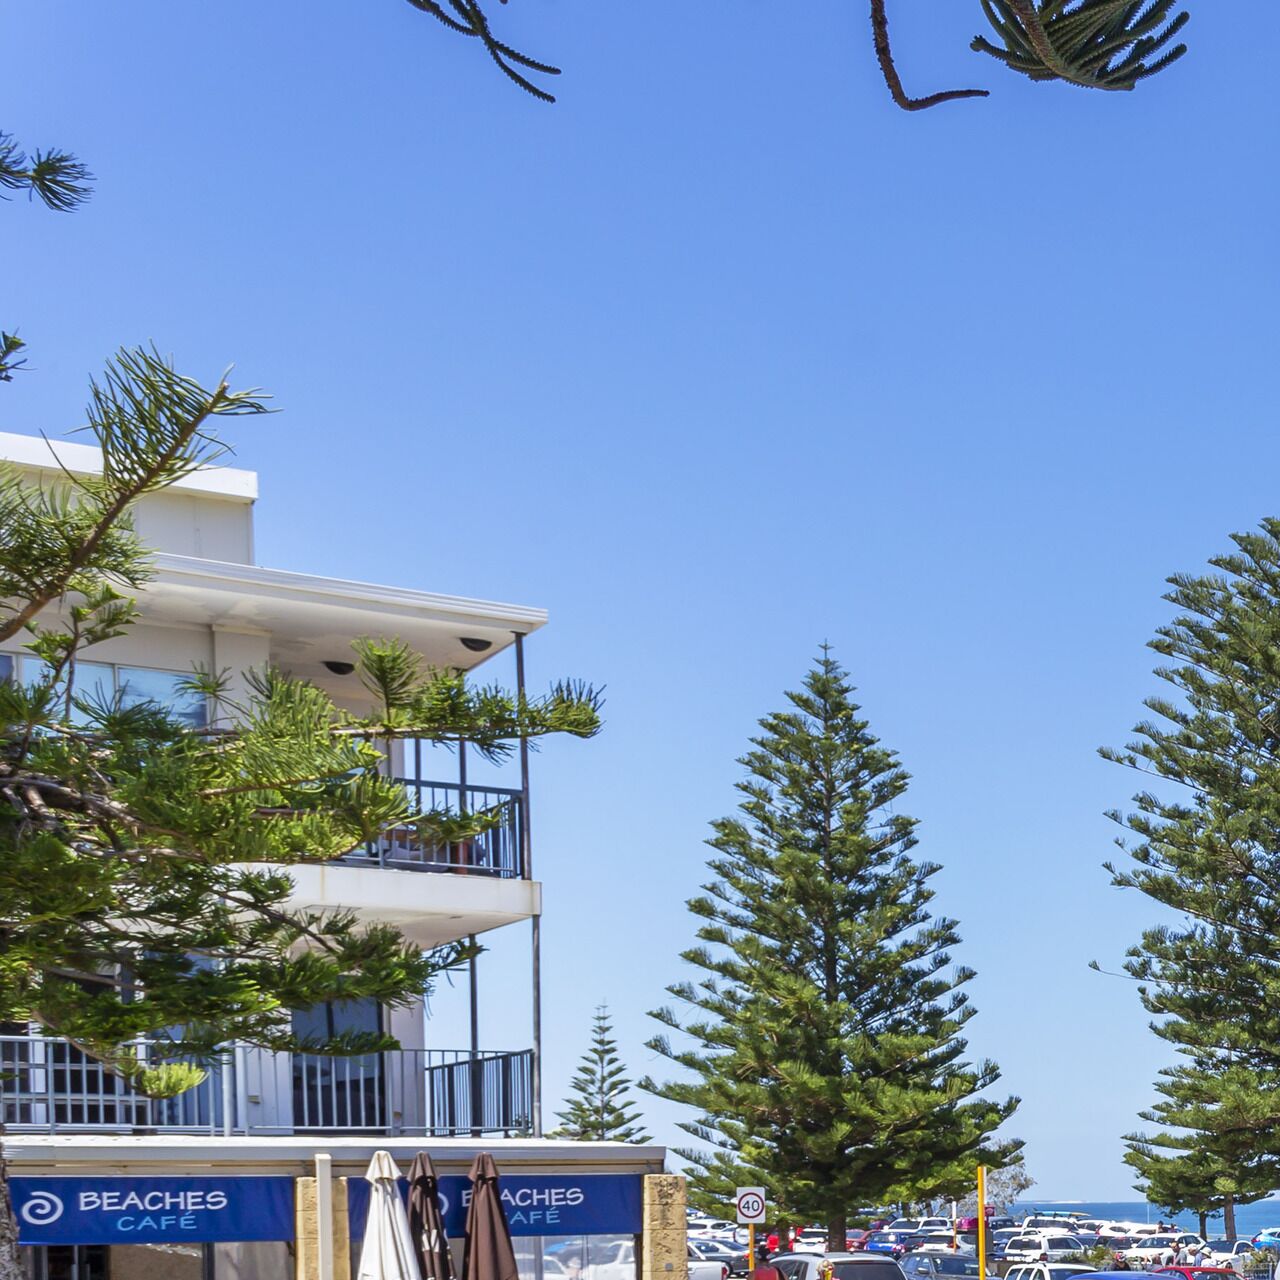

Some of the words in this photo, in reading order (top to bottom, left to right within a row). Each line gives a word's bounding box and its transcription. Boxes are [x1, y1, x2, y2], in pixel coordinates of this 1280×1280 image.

[79, 1191, 228, 1212] BEACHES
[741, 1200, 760, 1212] 40
[116, 1211, 197, 1232] CAFÉ
[504, 1207, 562, 1225] AFÉ
